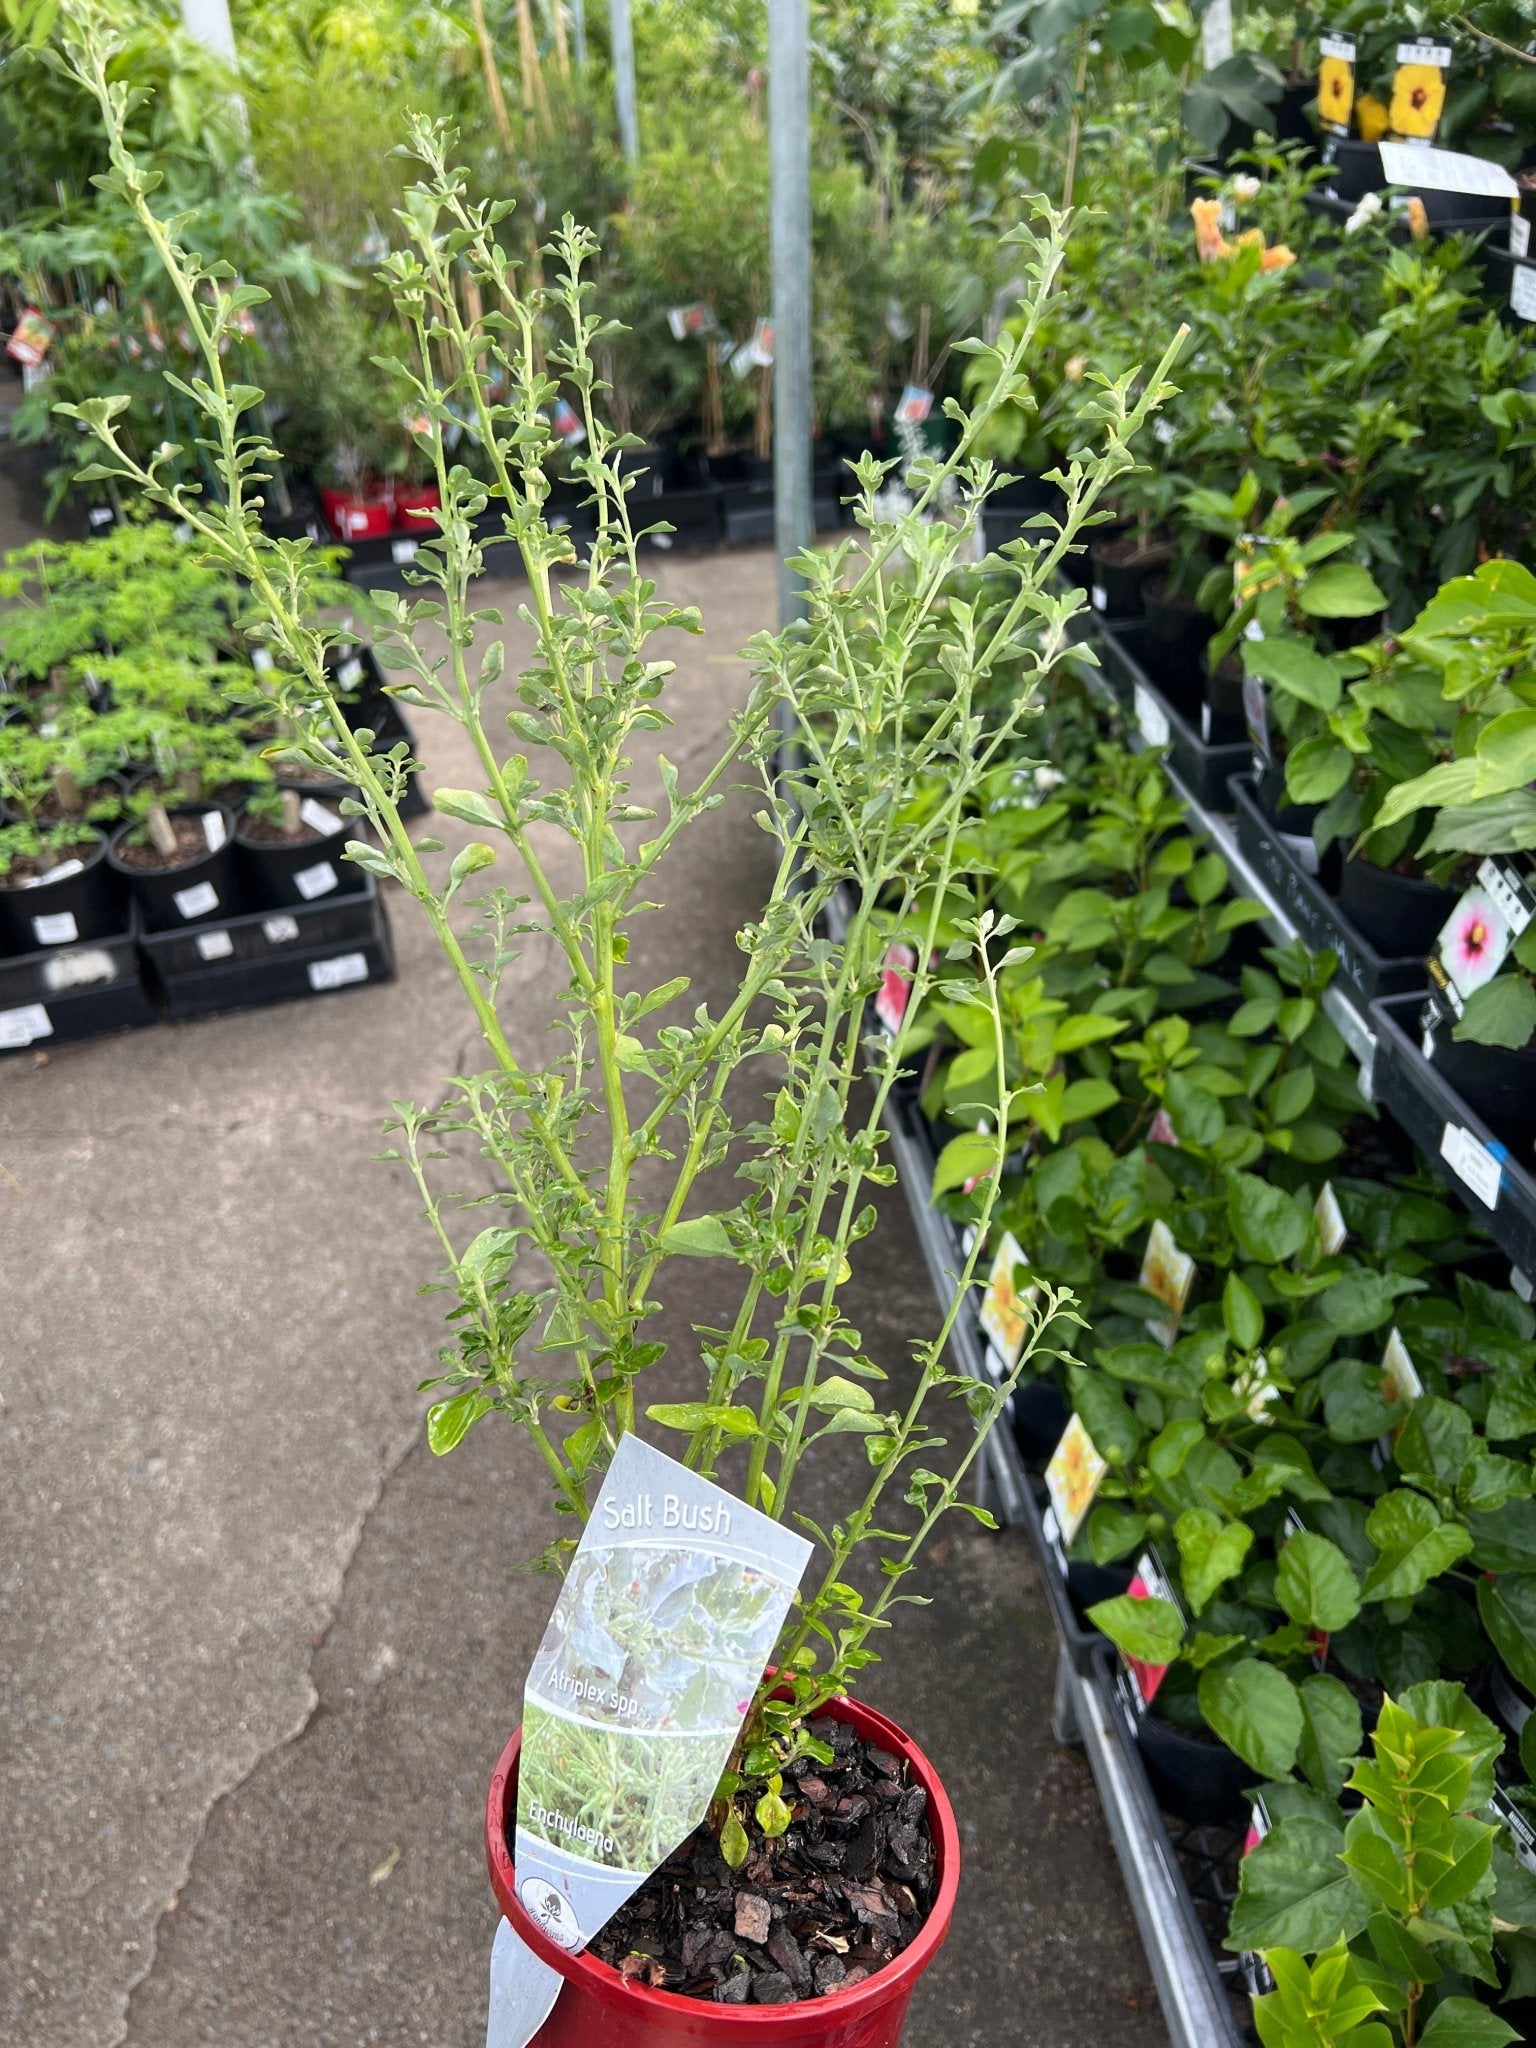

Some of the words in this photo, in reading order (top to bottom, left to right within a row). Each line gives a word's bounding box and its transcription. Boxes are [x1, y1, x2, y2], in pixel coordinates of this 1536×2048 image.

[603, 1494, 653, 1530] Salt
[662, 1494, 733, 1536] Bush
[548, 1667, 606, 1704] Atriplex
[528, 1799, 614, 1853] Enchylaena
